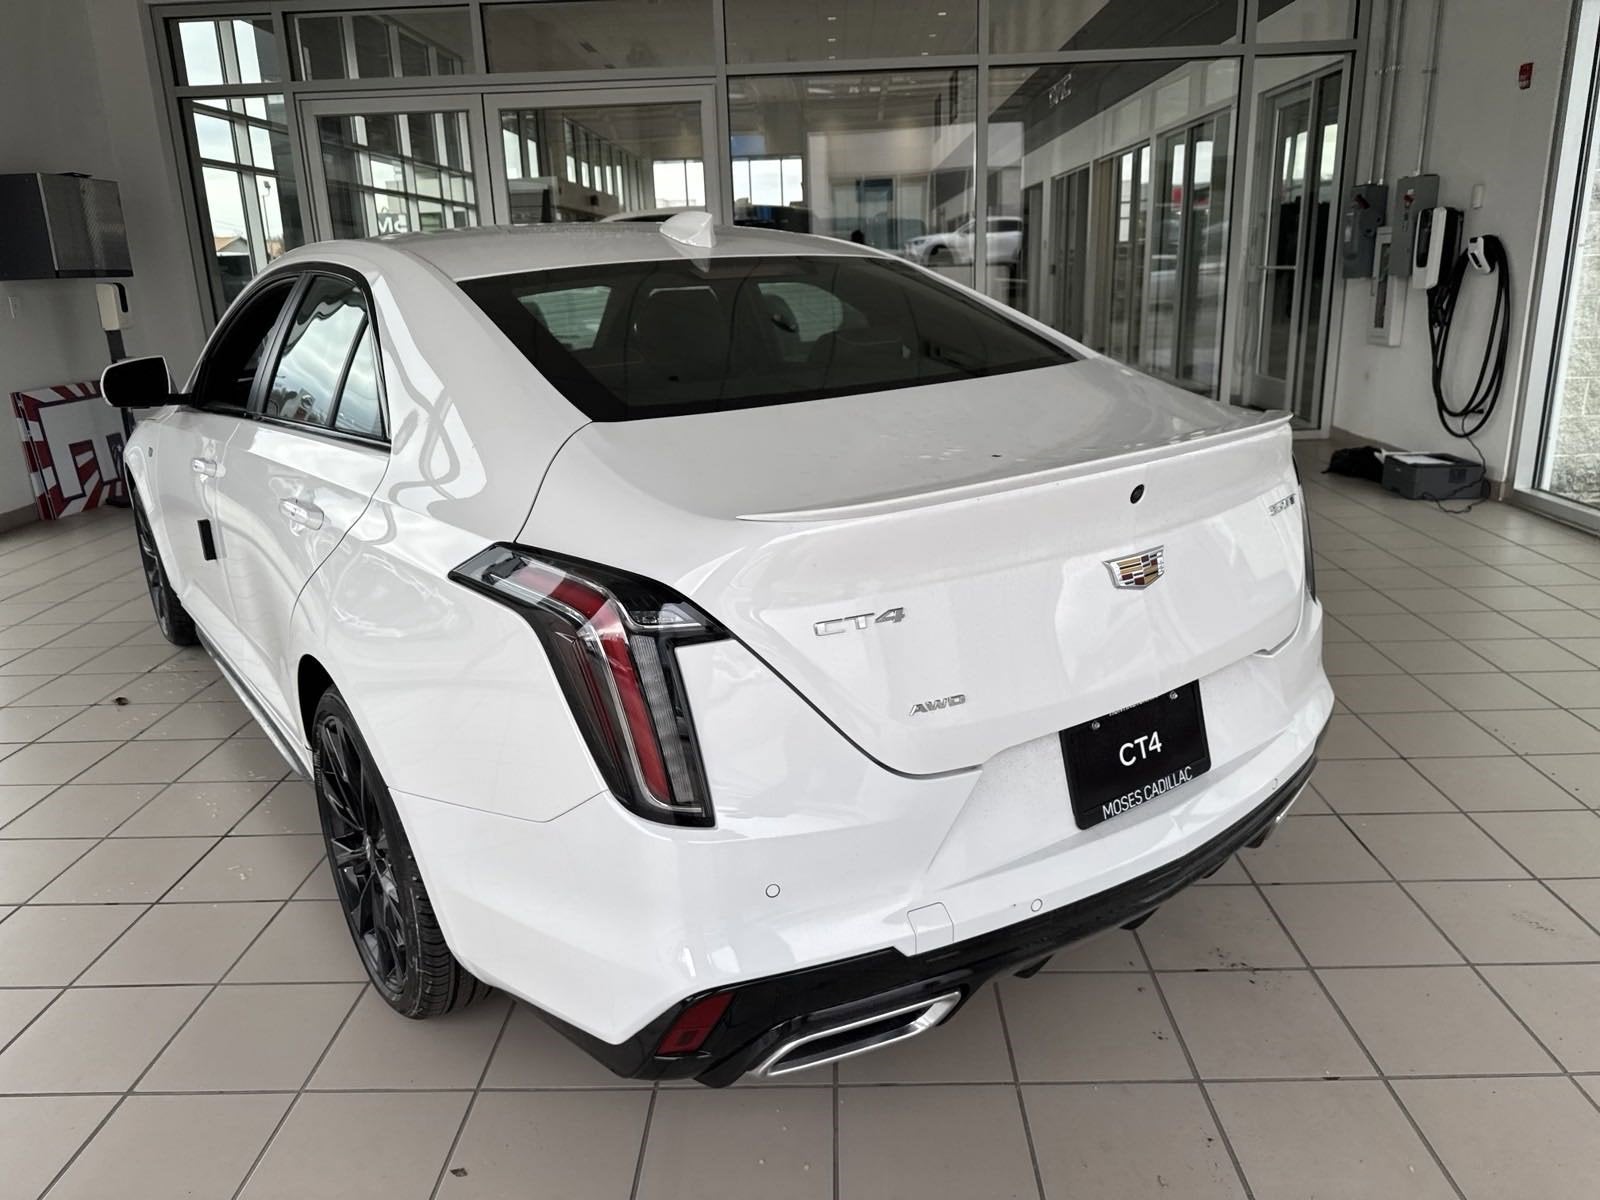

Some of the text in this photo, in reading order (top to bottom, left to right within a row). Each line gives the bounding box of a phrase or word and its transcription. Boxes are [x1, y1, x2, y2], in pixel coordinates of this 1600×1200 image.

[813, 606, 905, 636] CT4
[909, 694, 966, 716] AWD
[1118, 730, 1163, 767] CT4
[1102, 765, 1193, 820] MOSES CADILLAC
